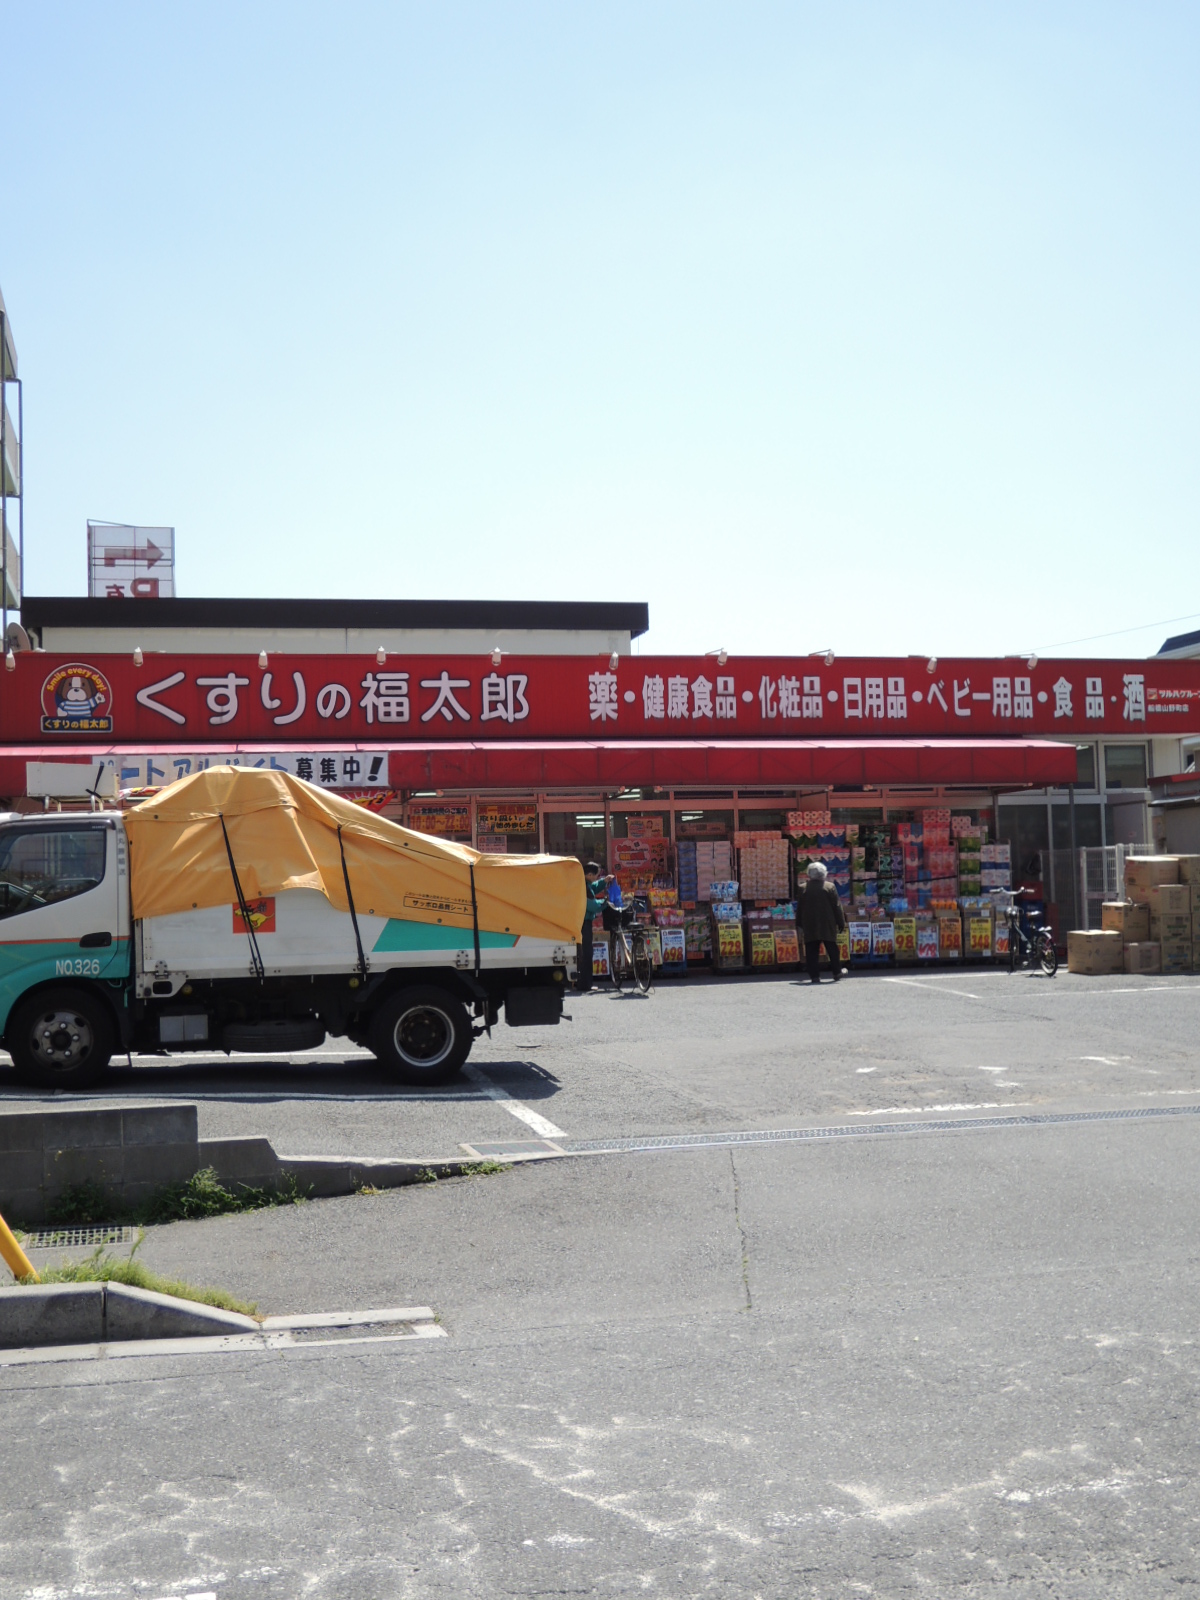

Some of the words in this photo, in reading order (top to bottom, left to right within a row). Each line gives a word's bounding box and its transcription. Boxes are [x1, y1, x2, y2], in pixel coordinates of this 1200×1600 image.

[46, 670, 67, 692] Smile
[67, 667, 92, 678] every
[91, 674, 107, 691] day!
[136, 670, 530, 725] くすりの福太郎
[44, 719, 109, 730] くすりの福太郎
[720, 940, 742, 957] 228
[850, 938, 869, 954] 158
[895, 934, 914, 949] 98
[663, 946, 684, 962] 698
[753, 949, 773, 965] 228
[777, 946, 798, 962] 268
[55, 959, 100, 976] NO.326
